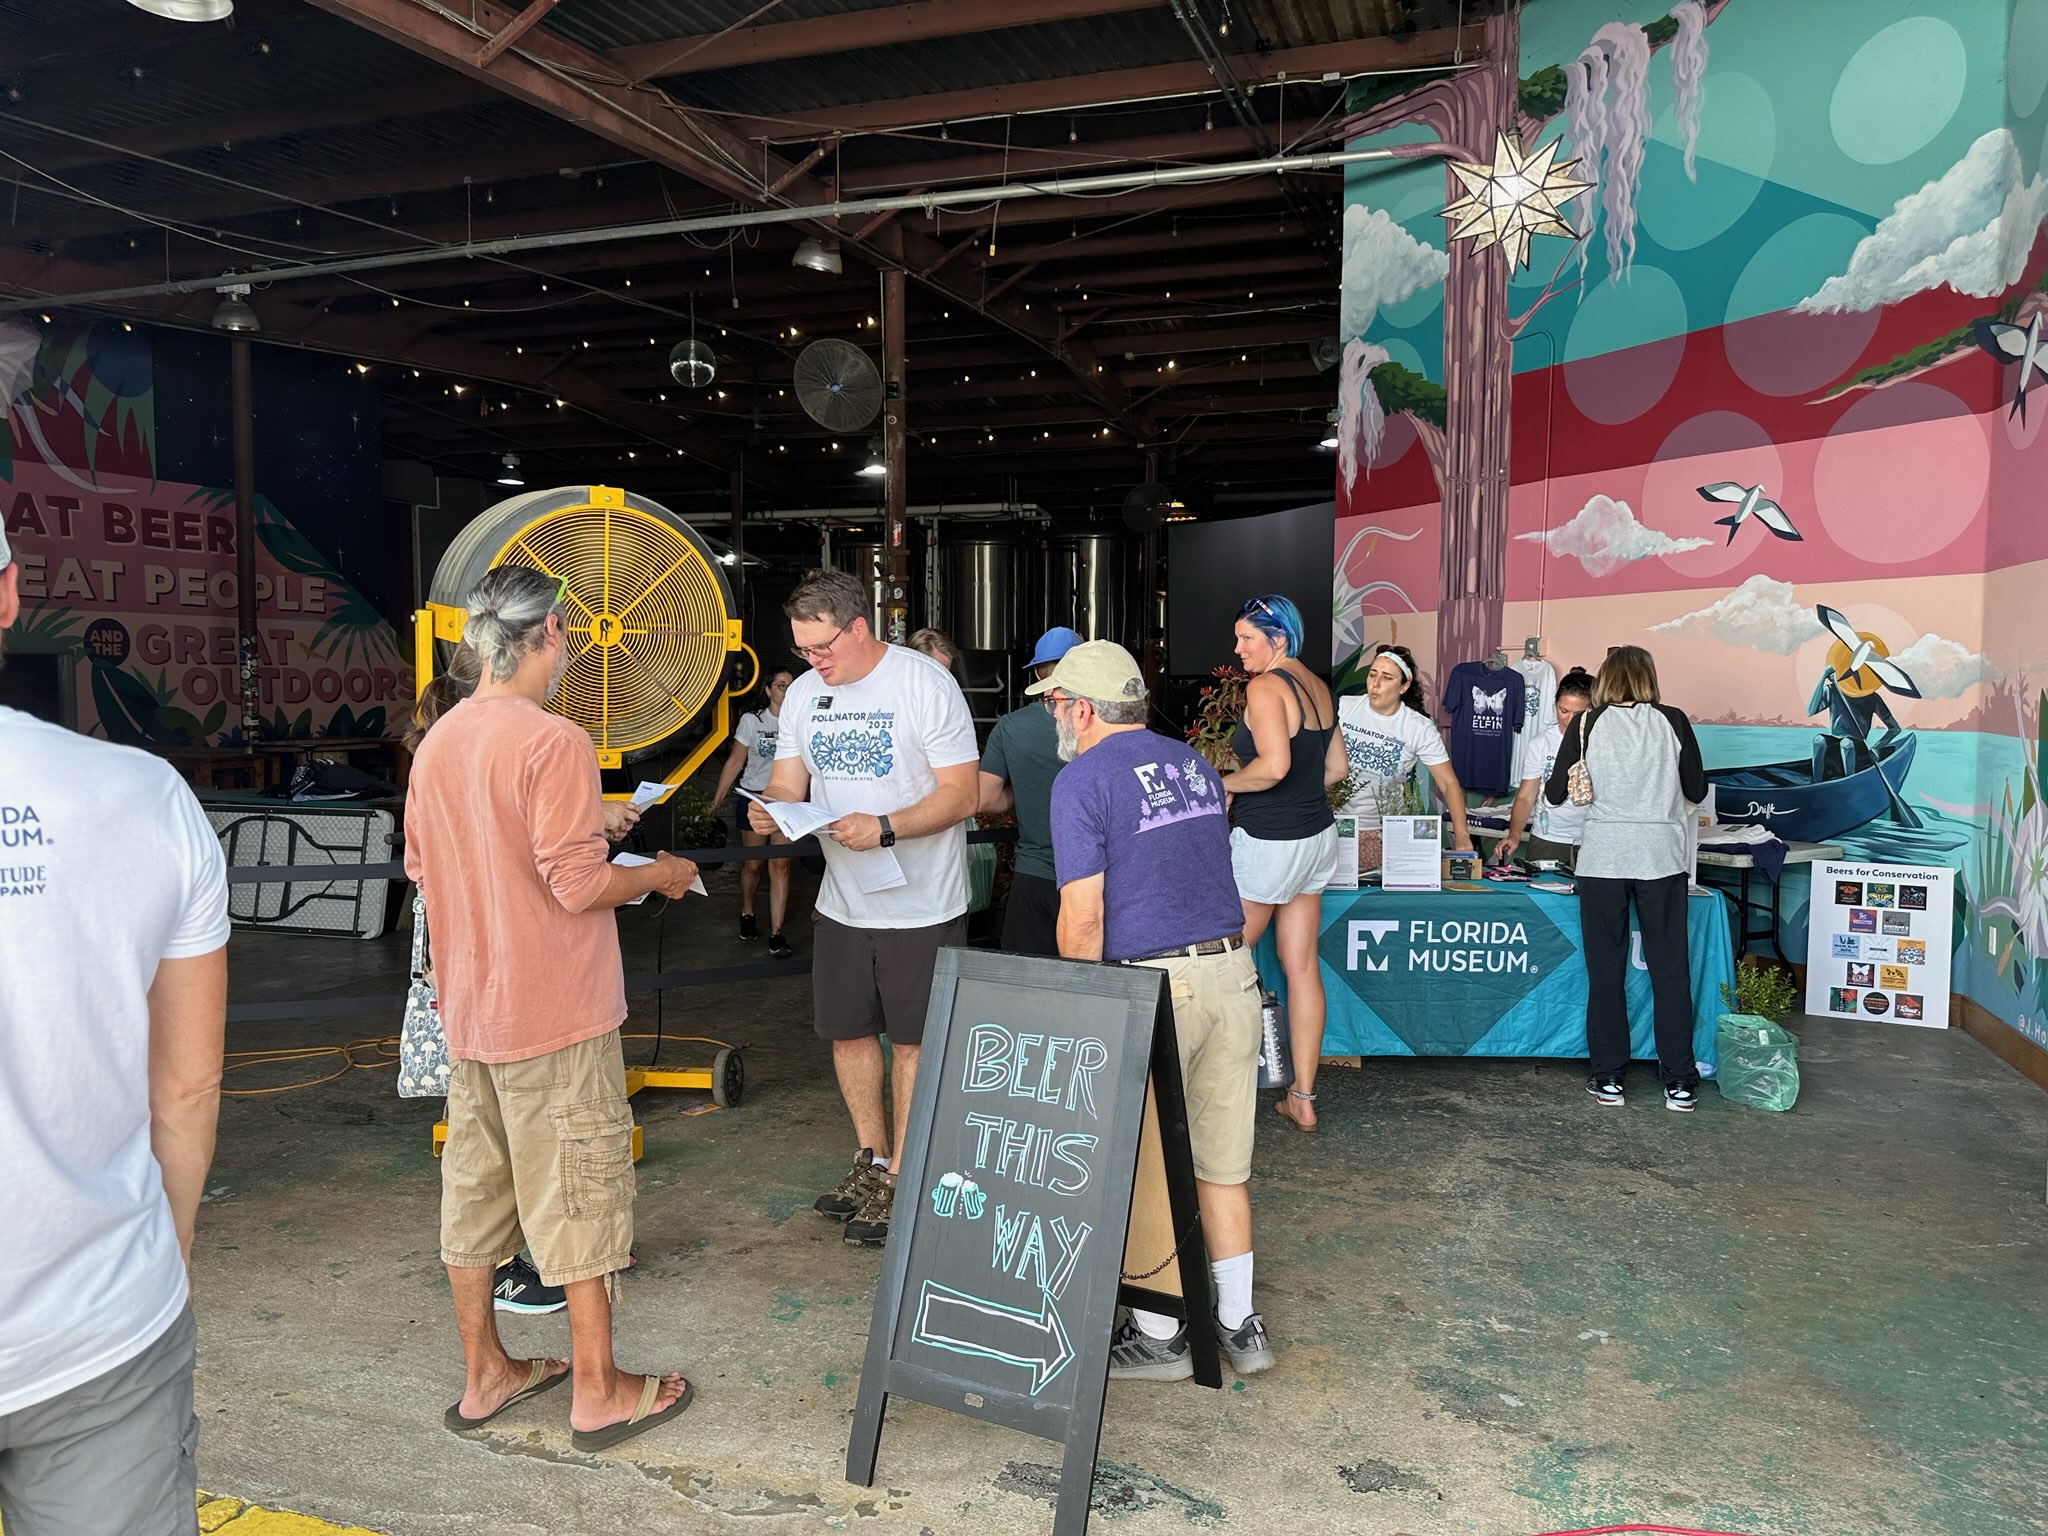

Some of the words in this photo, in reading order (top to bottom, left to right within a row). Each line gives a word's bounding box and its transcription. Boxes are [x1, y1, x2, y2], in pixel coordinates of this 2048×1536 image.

[103, 502, 237, 557] BEER
[145, 563, 326, 614] PEOPLE
[90, 629, 124, 644] AND
[92, 643, 122, 656] THE
[182, 667, 417, 707] OUTDOORS
[868, 720, 893, 729] 2023
[1342, 722, 1385, 740] POLLINATOR
[1472, 719, 1503, 730] ELFIN
[1148, 789, 1173, 802] FLORIDA
[1826, 866, 1854, 875] Beers
[1856, 868, 1870, 876] for
[1872, 869, 1939, 880] Conservation
[1409, 920, 1529, 945] FLORIDA
[961, 1023, 1109, 1119] BEER
[965, 1112, 1100, 1196] THIS
[991, 1204, 1094, 1300] WAY
